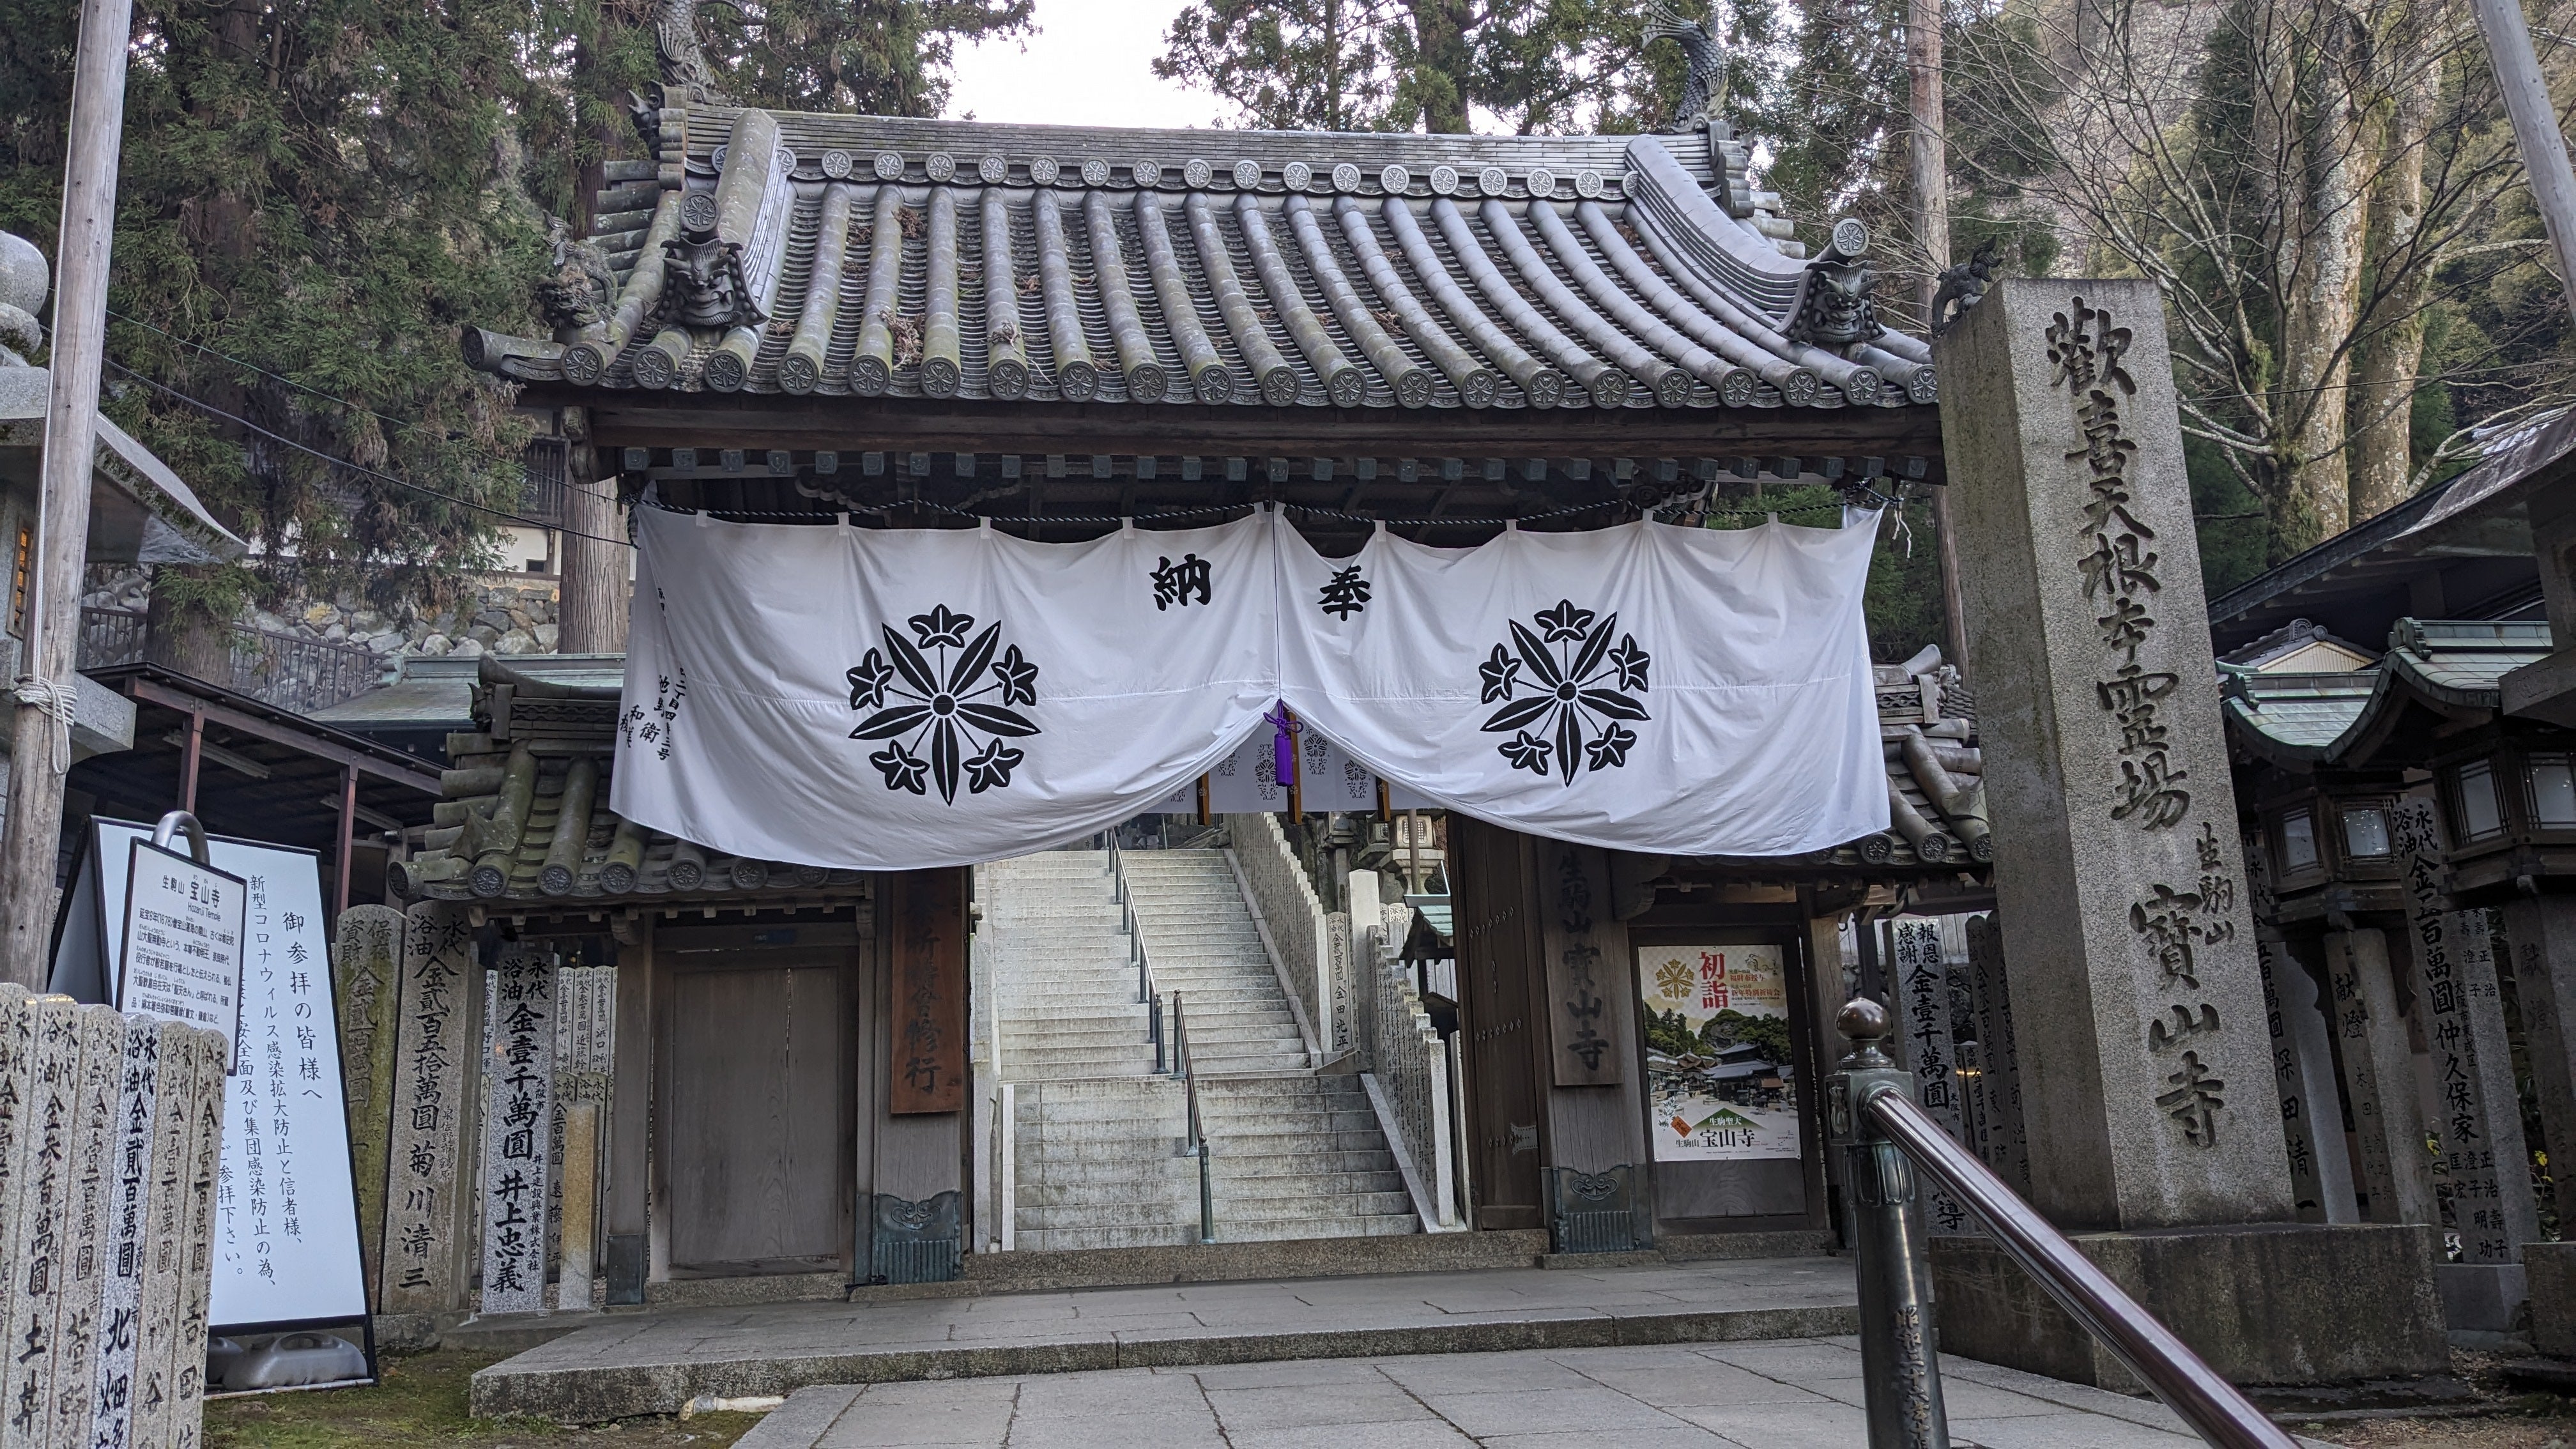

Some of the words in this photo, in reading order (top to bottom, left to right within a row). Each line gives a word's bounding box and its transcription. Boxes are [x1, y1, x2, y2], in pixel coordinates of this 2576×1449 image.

[2393, 808, 2418, 859] 浴油
[2415, 804, 2439, 851] 永代
[162, 875, 185, 895] 生駒山
[190, 880, 220, 908] 宝山寺
[2196, 822, 2235, 945] 生駒山
[205, 908, 221, 922] Temple
[408, 914, 438, 958] 浴油
[440, 914, 467, 957] 永代
[1897, 923, 1917, 964] 感謝
[1917, 922, 1939, 964] 報恩
[501, 958, 523, 1001] 浴油
[526, 956, 549, 1002] 永代
[584, 969, 592, 987] 永代
[1698, 951, 1728, 1009] 初詣
[2463, 949, 2481, 999] 澄子
[2479, 949, 2497, 998] 正治
[282, 912, 322, 1099] 御参拝の皆様へ
[557, 1026, 568, 1050] 中川
[125, 1028, 144, 1095] 浴油
[140, 1027, 158, 1096] 永代
[535, 1077, 547, 1111] 大阪市
[561, 1078, 574, 1102] 永代
[578, 1078, 592, 1101] 浴油
[591, 1078, 604, 1102] 永代
[1949, 1092, 1961, 1123] 大阪市
[1675, 1138, 1699, 1148] 生駒山
[1699, 1128, 1756, 1148] 宝山寺
[1709, 1116, 1742, 1126] 生駒聖天
[398, 1142, 436, 1289] 菊川清三
[489, 1169, 530, 1294] 井上忠義
